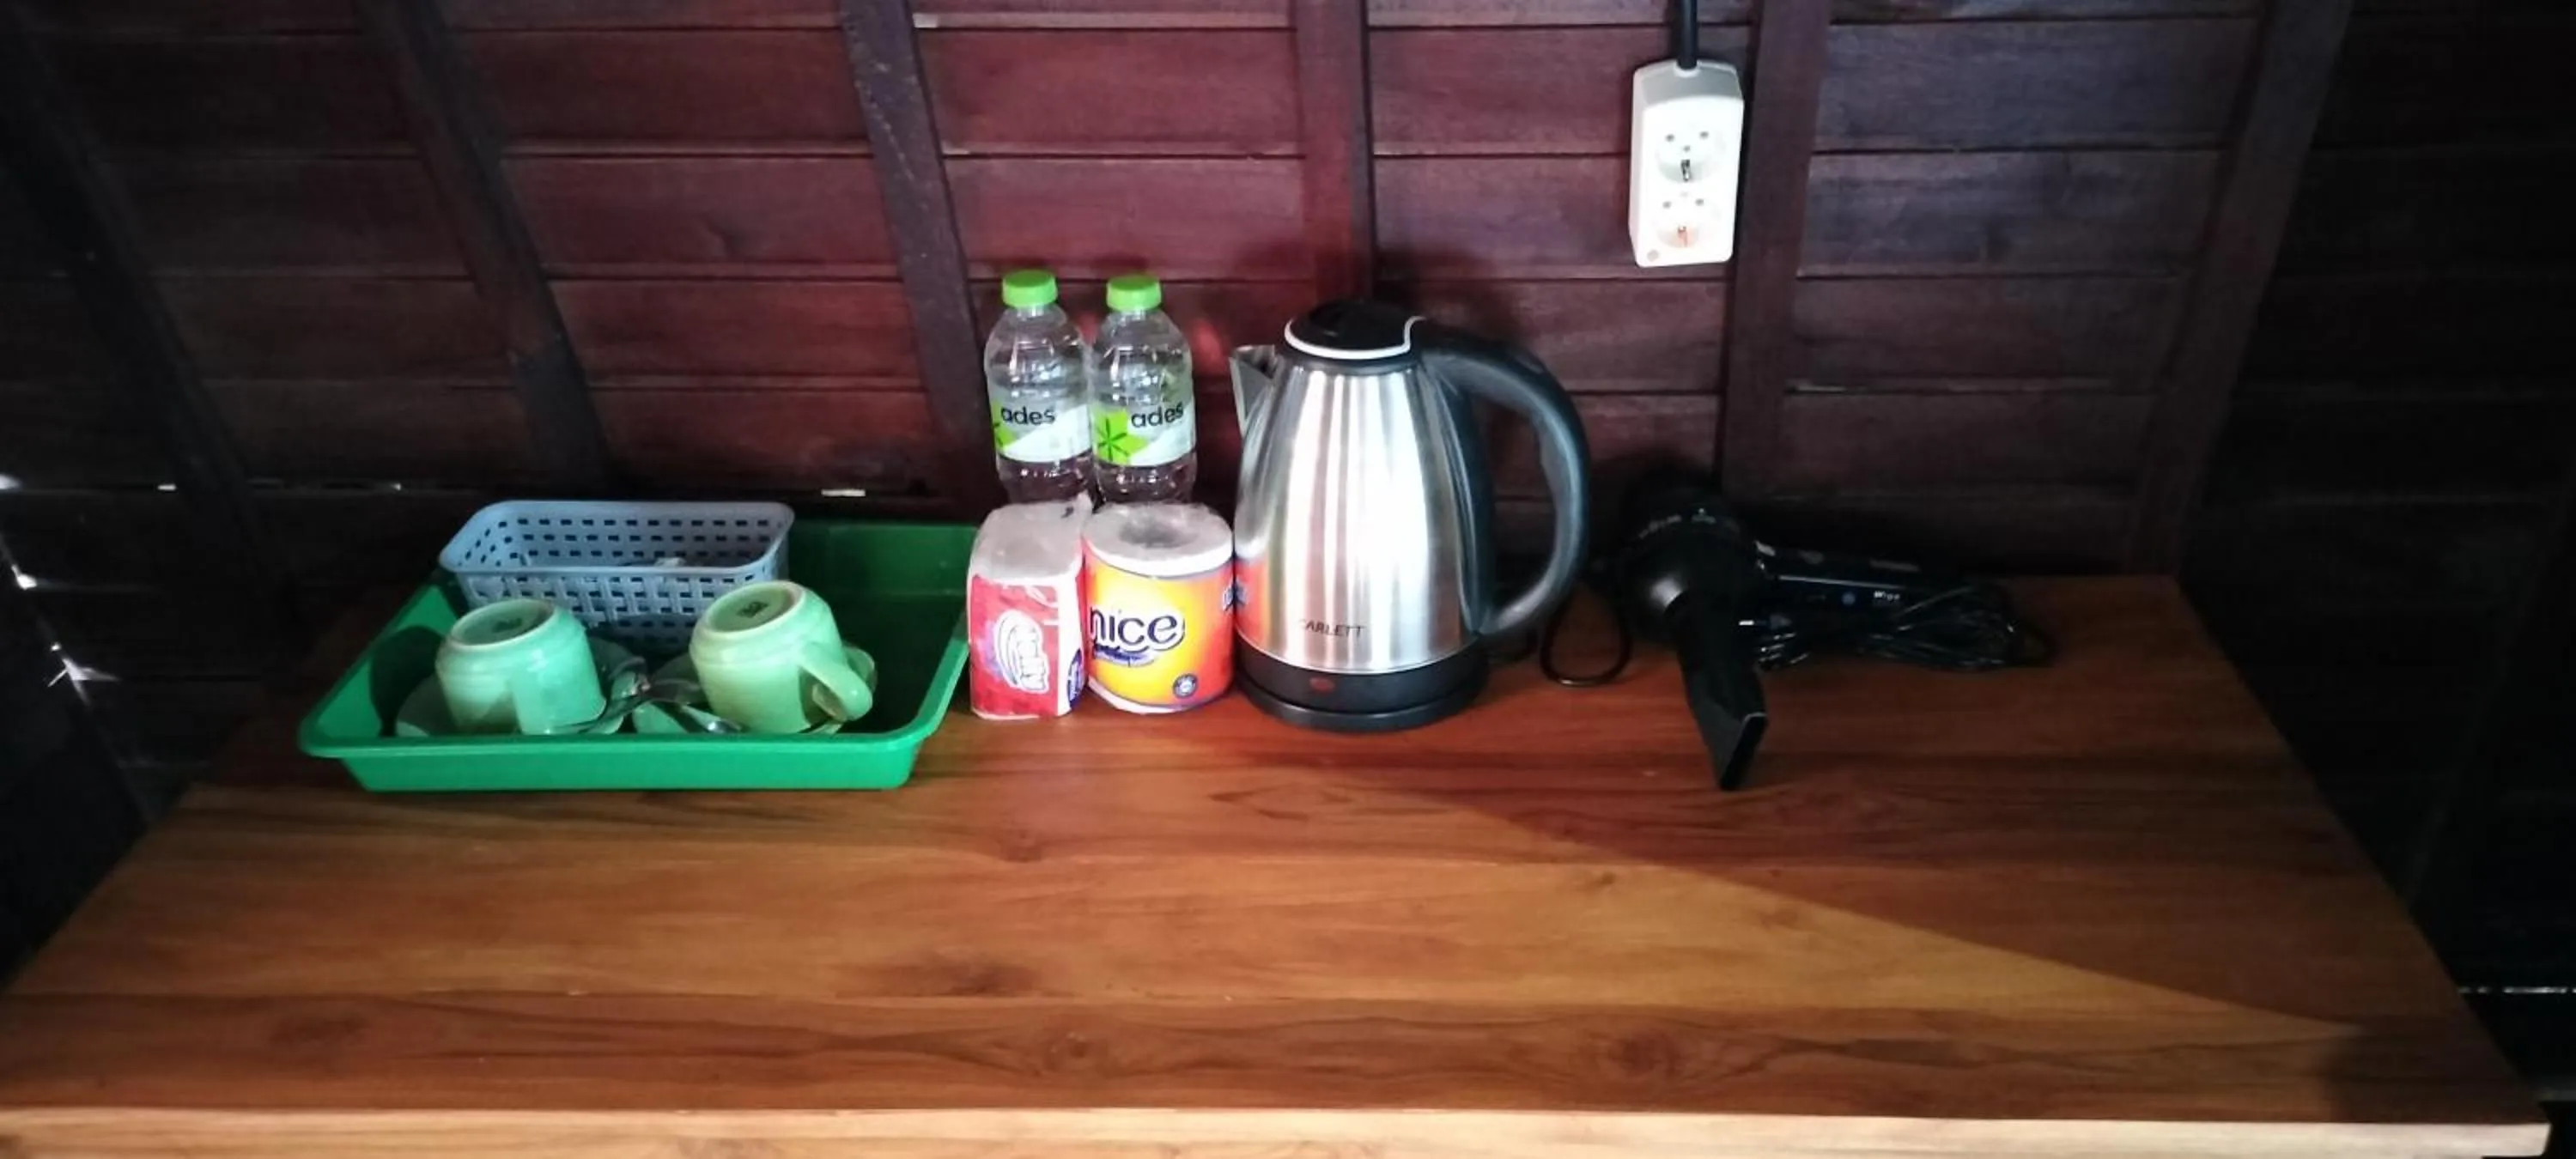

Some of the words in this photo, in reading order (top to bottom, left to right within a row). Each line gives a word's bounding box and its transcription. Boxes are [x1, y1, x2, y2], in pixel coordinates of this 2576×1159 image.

[1000, 405, 1055, 426] ades
[1131, 401, 1184, 428] ades
[1089, 607, 1177, 646] nice
